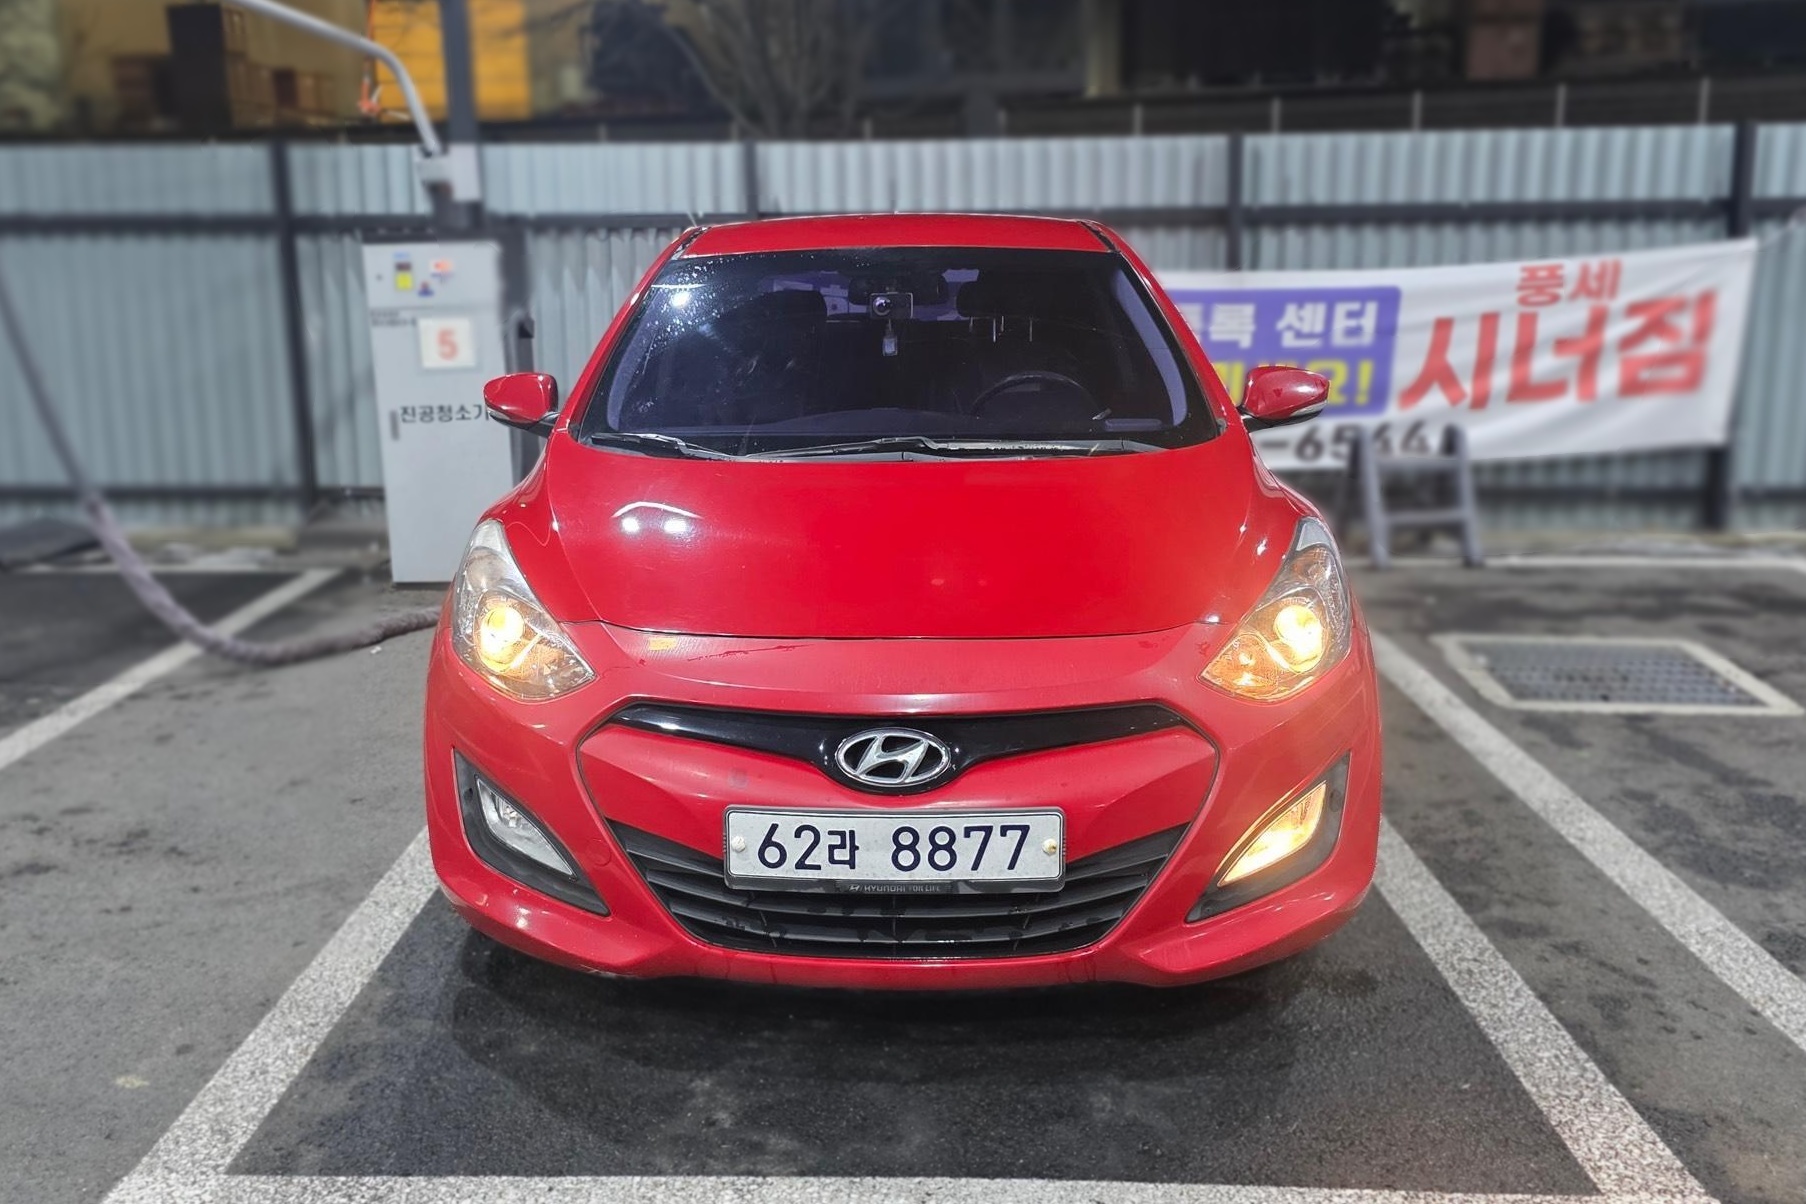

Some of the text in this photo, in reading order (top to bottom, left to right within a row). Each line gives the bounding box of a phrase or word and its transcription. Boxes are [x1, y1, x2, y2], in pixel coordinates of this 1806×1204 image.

[1516, 260, 1622, 306] 풍세
[1276, 301, 1378, 348] 센터
[436, 328, 459, 361] 5
[401, 403, 489, 423] 진공청소기
[757, 823, 1031, 872] 62라 8877
[864, 884, 906, 892] HYUNDAI
